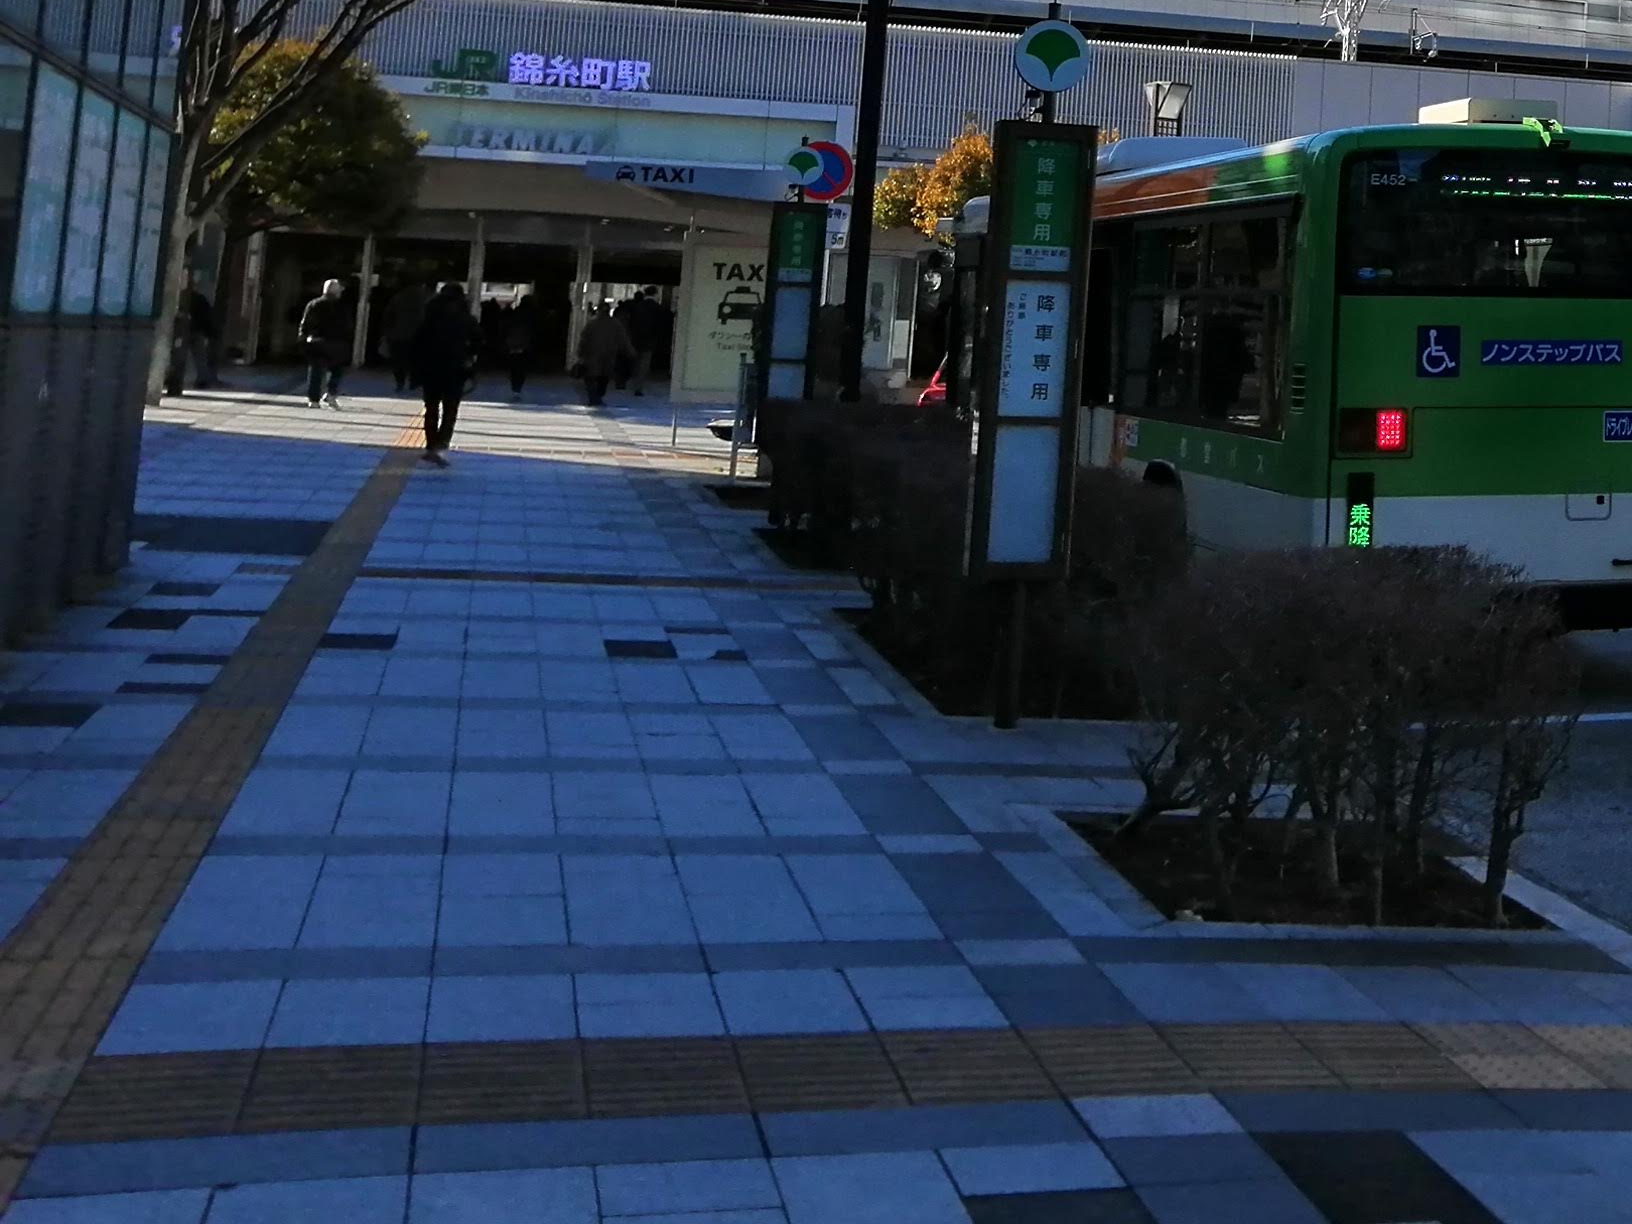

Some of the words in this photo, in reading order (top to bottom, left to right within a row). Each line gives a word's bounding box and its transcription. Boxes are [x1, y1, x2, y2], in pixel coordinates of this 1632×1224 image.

[508, 51, 651, 92] 錦糸町駅
[641, 166, 695, 185] TAXI
[1034, 157, 1056, 241] 降車専用
[713, 262, 765, 282] TAX
[1031, 295, 1055, 401] 降車専用
[1482, 343, 1622, 364] ノンステップバス
